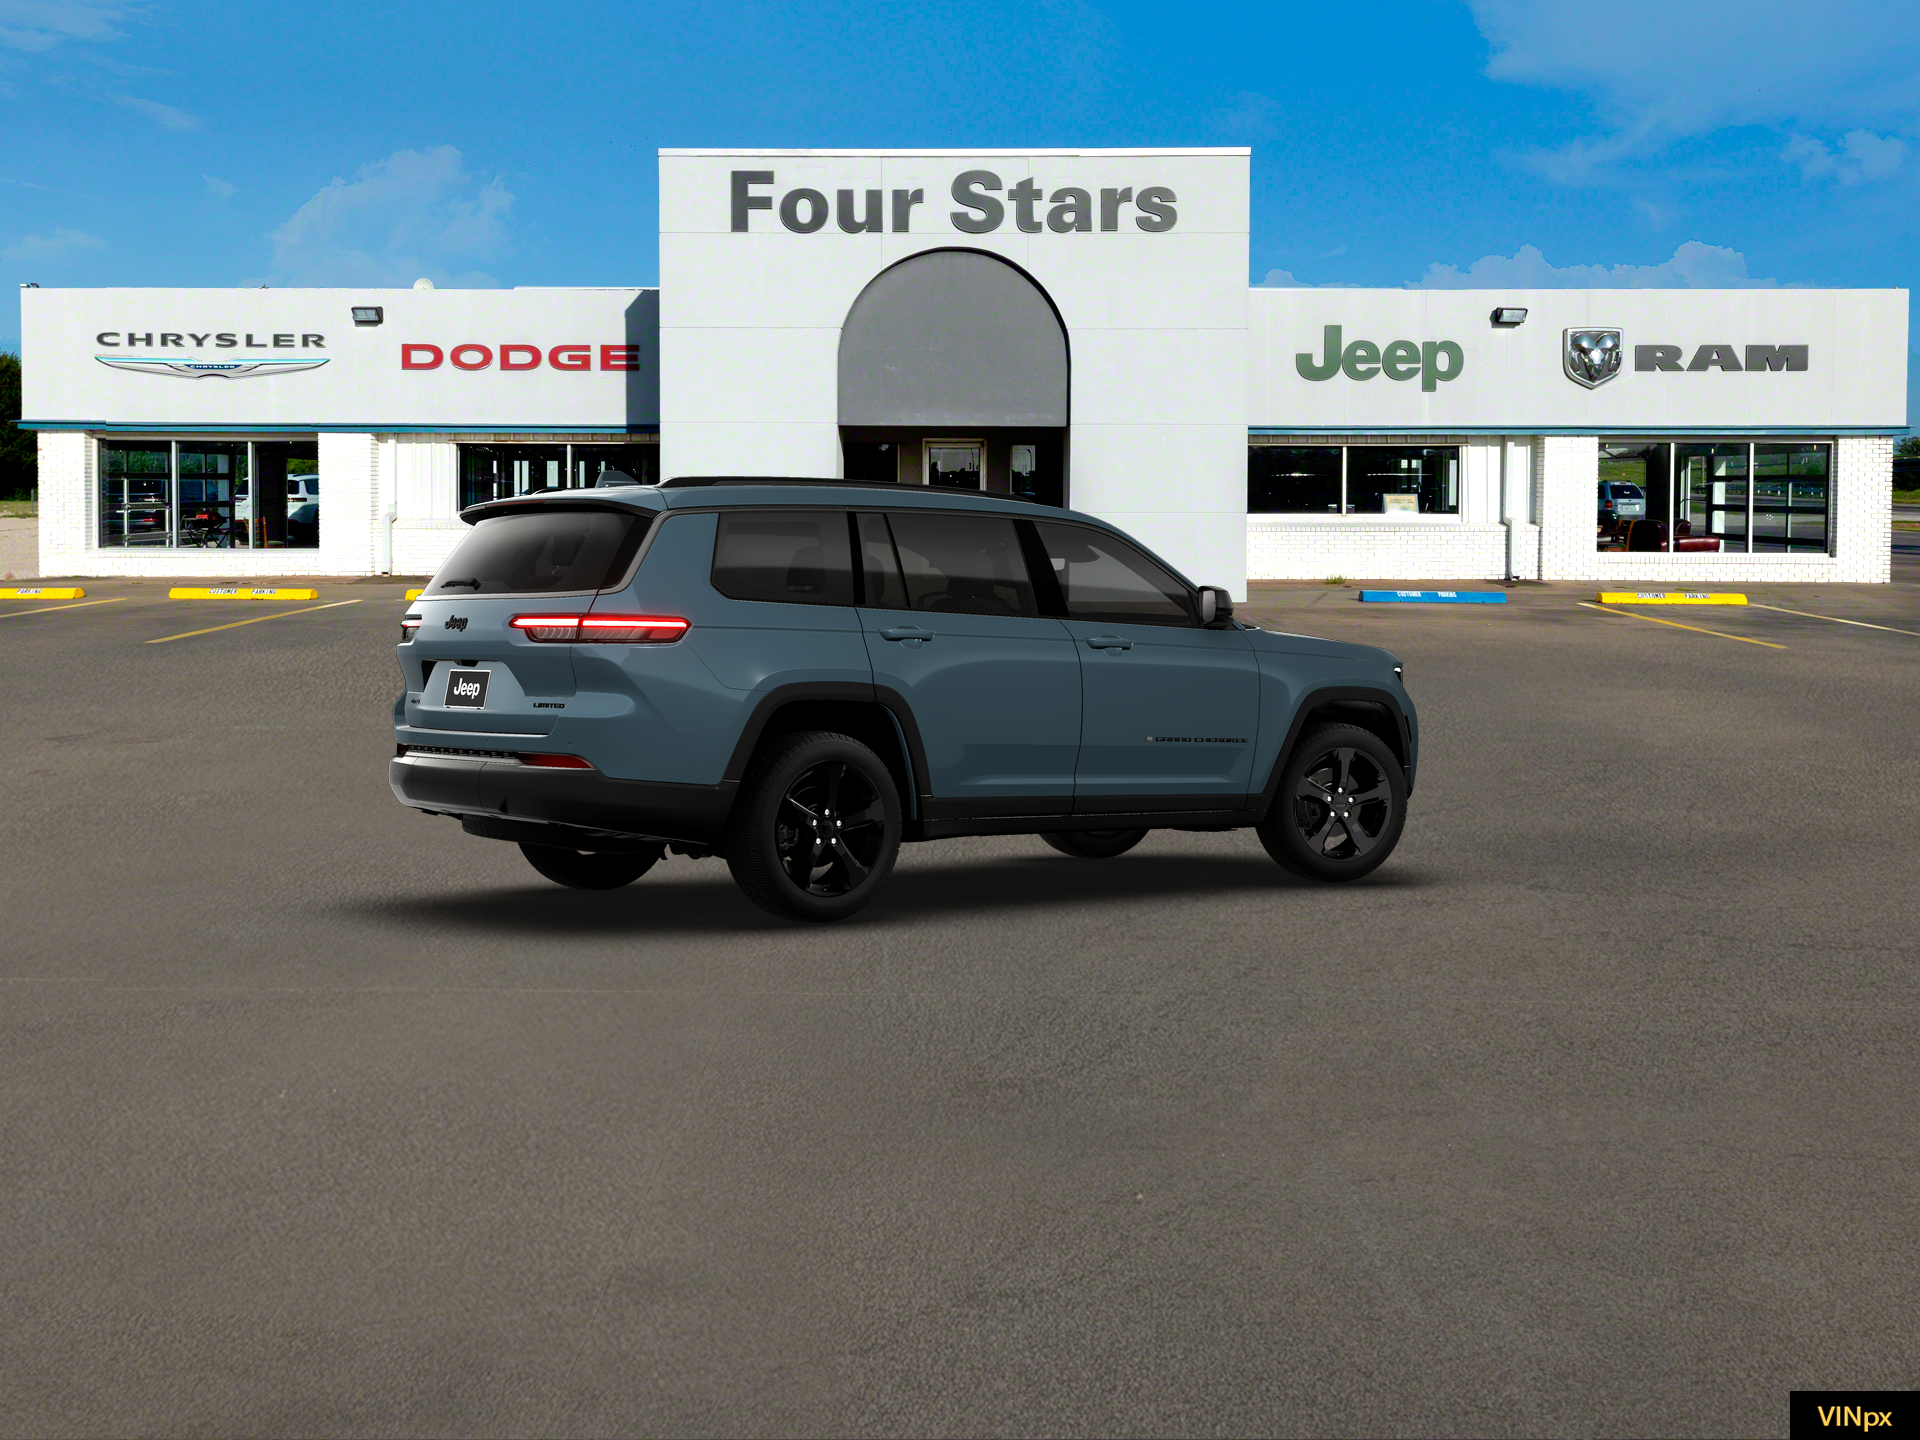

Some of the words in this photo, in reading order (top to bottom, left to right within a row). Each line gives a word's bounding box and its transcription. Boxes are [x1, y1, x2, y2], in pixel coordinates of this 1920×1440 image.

[730, 170, 924, 233] Four
[950, 169, 1178, 233] Stars
[96, 332, 326, 348] CHRYSLER
[401, 343, 640, 371] DODGE
[1296, 325, 1464, 392] Jeep
[1634, 344, 1809, 372] RAM
[444, 615, 468, 632] Jeep
[453, 678, 480, 699] Jeep
